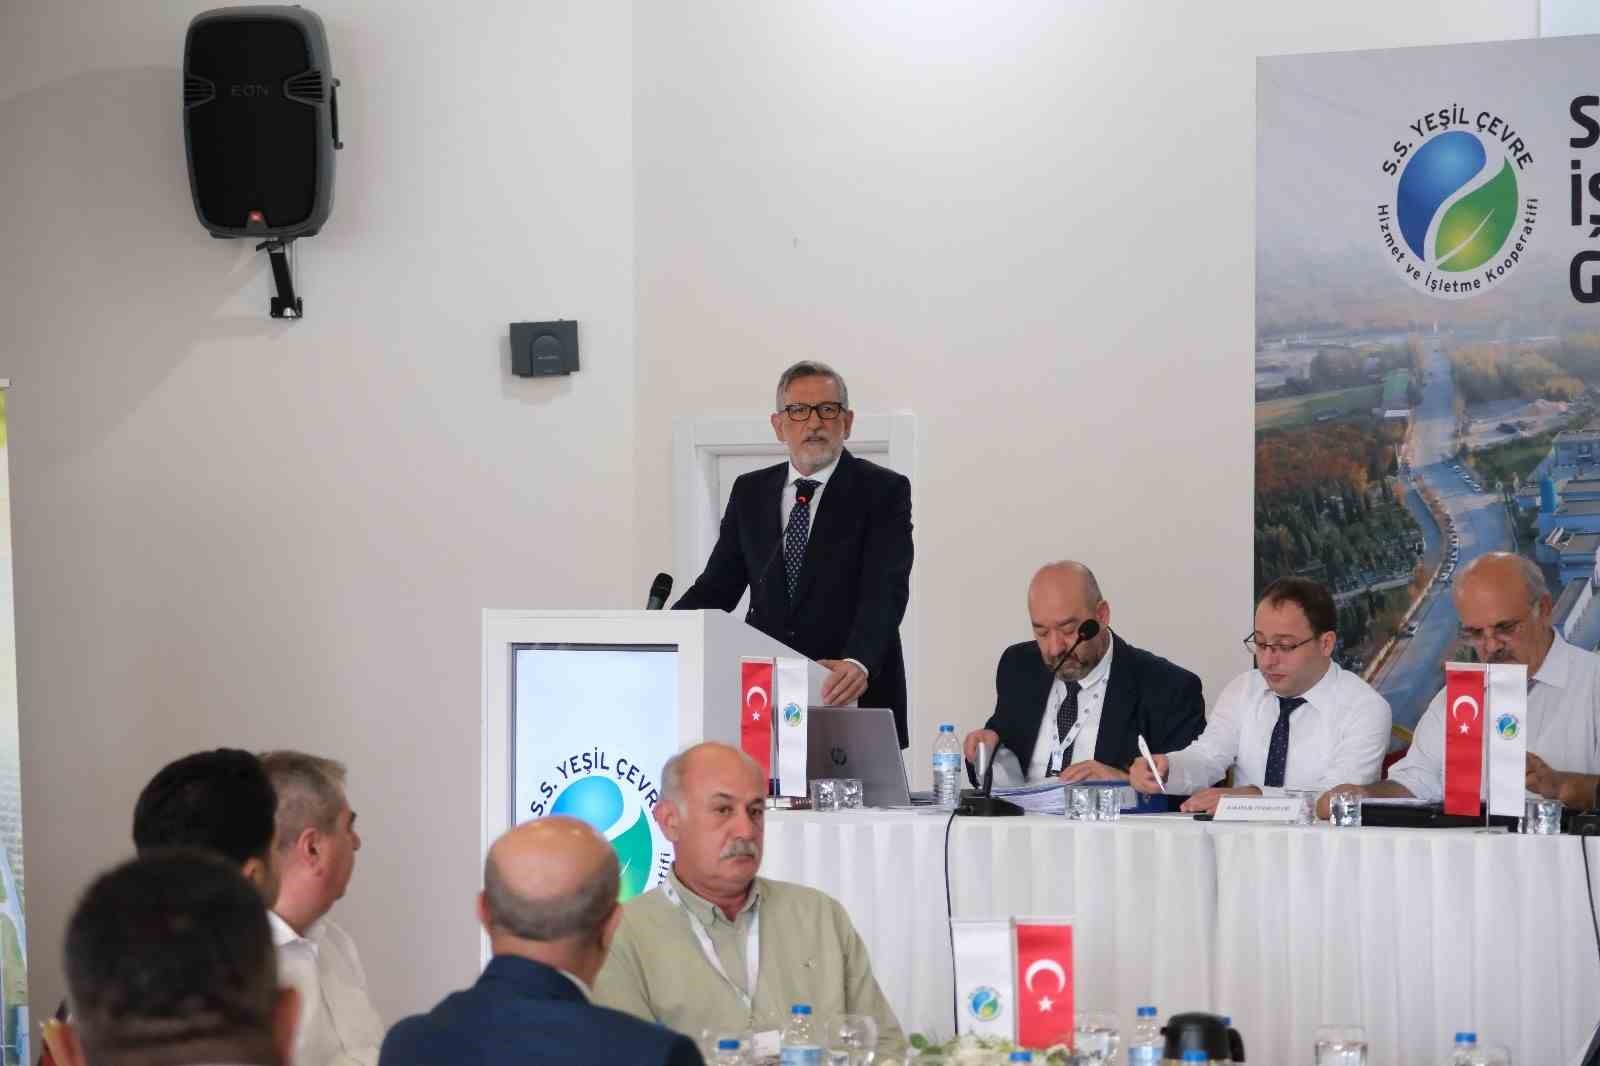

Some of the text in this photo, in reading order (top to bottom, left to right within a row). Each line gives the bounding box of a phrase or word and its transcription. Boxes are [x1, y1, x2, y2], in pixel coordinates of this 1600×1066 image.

[1382, 103, 1534, 176] S.S. YEŞİL ÇEVRE
[1377, 198, 1539, 293] Hizmet ve İşletme Kooperatifi
[530, 746, 660, 816] S.S. YEŞİL ÇEVR
